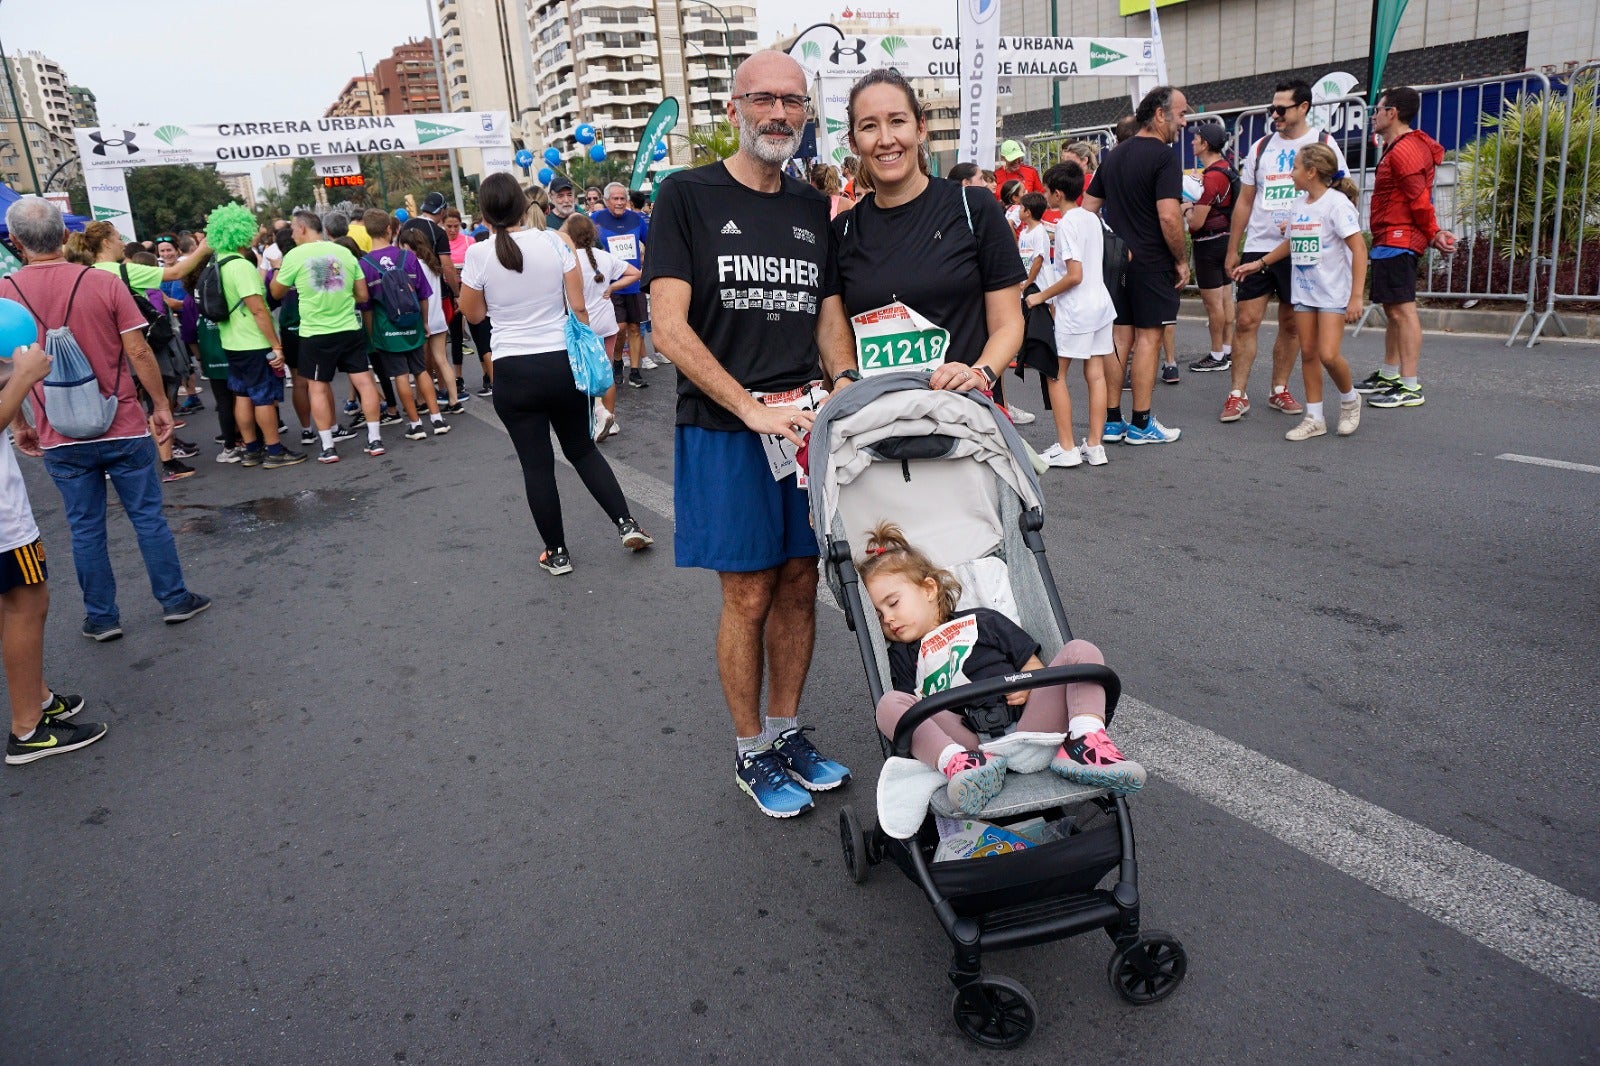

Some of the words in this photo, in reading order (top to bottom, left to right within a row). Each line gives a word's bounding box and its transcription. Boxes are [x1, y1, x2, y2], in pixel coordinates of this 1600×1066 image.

[856, 8, 900, 19] Santander
[1012, 37, 1074, 50] URBANA
[1018, 58, 1078, 75] MÁLAGA
[218, 120, 312, 136] CARRERA
[317, 116, 395, 132] URBANA
[216, 143, 291, 160] CIUDAD
[297, 142, 322, 156] DE
[328, 137, 405, 154] MÁLAGA
[322, 165, 354, 175] META
[91, 184, 124, 193] málaga
[615, 242, 633, 251] 1004
[717, 254, 819, 288] FINISHER
[864, 335, 944, 369] 21218
[1003, 672, 1033, 683] Inglesina
